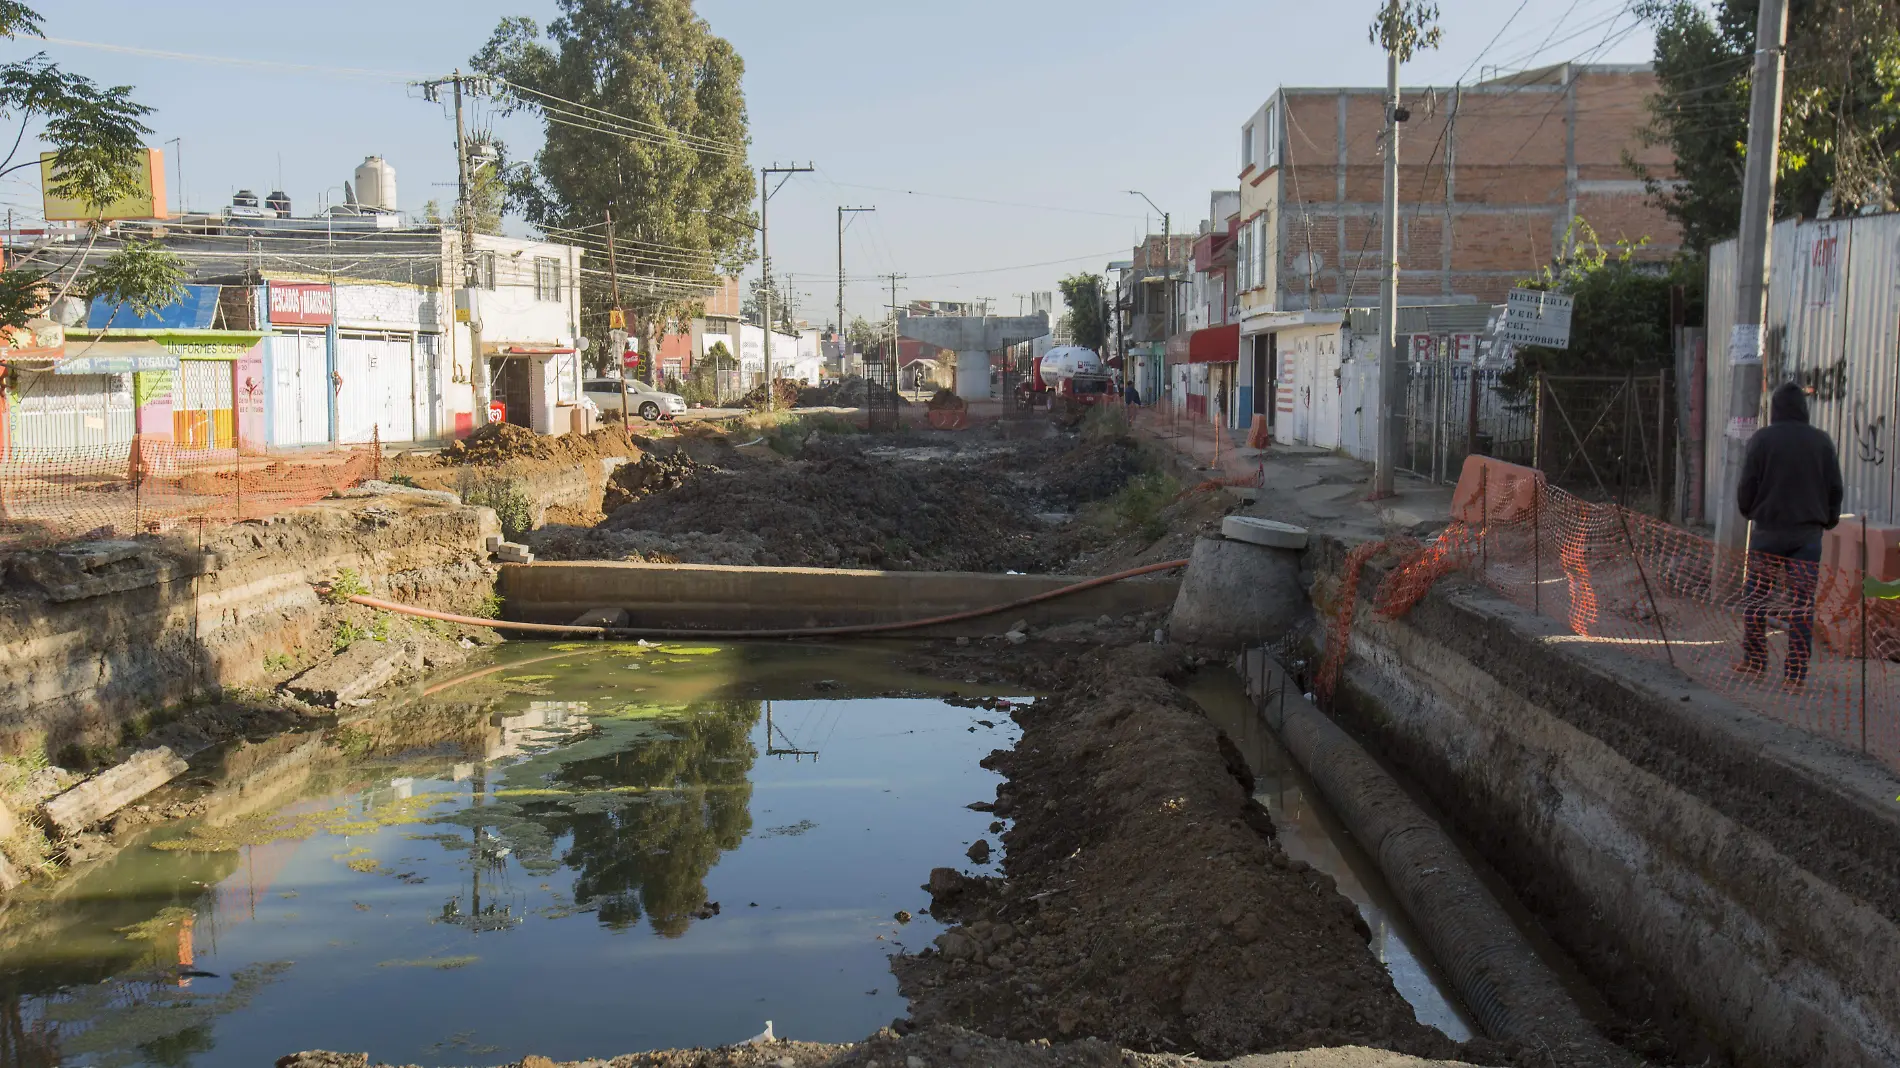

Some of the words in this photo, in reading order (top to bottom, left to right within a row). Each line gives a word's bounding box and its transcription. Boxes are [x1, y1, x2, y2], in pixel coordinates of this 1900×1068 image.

[271, 287, 300, 313] PESCADOS
[303, 290, 332, 315] MARISCOS
[1510, 292, 1571, 308] HERRERIA
[1509, 308, 1542, 320] VERA
[167, 339, 217, 355] UNIFORMES
[138, 356, 178, 370] REGALOS
